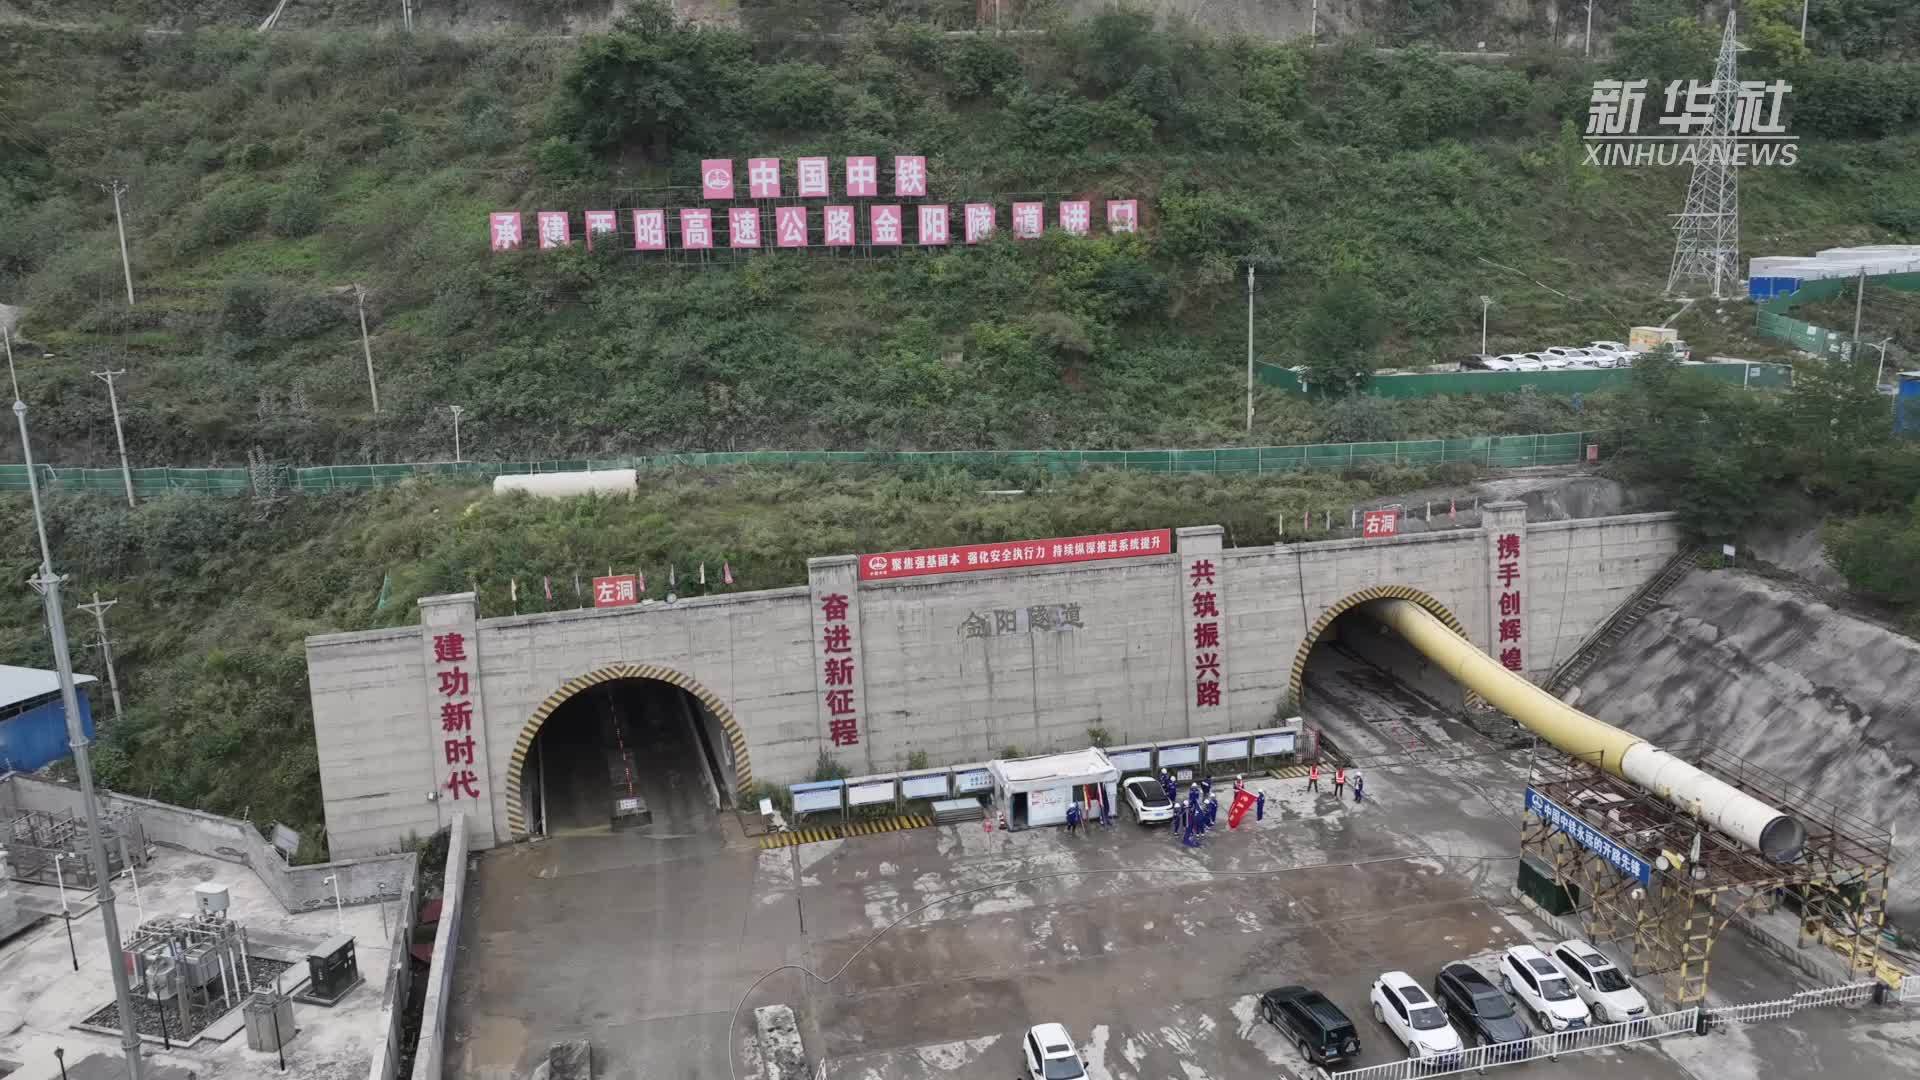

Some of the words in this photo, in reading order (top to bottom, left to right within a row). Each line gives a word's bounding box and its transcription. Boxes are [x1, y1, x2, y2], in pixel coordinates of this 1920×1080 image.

[751, 158, 924, 197] 中国中铁
[891, 553, 960, 571] 聚焦强基固本
[967, 546, 1046, 565] 强化安全执行力
[1052, 535, 1161, 558] 持续纵深推进系统提升
[1366, 514, 1395, 534] 右洞
[597, 580, 634, 604] 左洞
[1497, 533, 1522, 672] 携手创辉煌
[821, 593, 859, 747] 奋进新征程
[1190, 559, 1221, 707] 共筑振兴路
[433, 632, 480, 801] 建功新时代
[1544, 803, 1641, 877] 中国中铁永远的开路先锋
